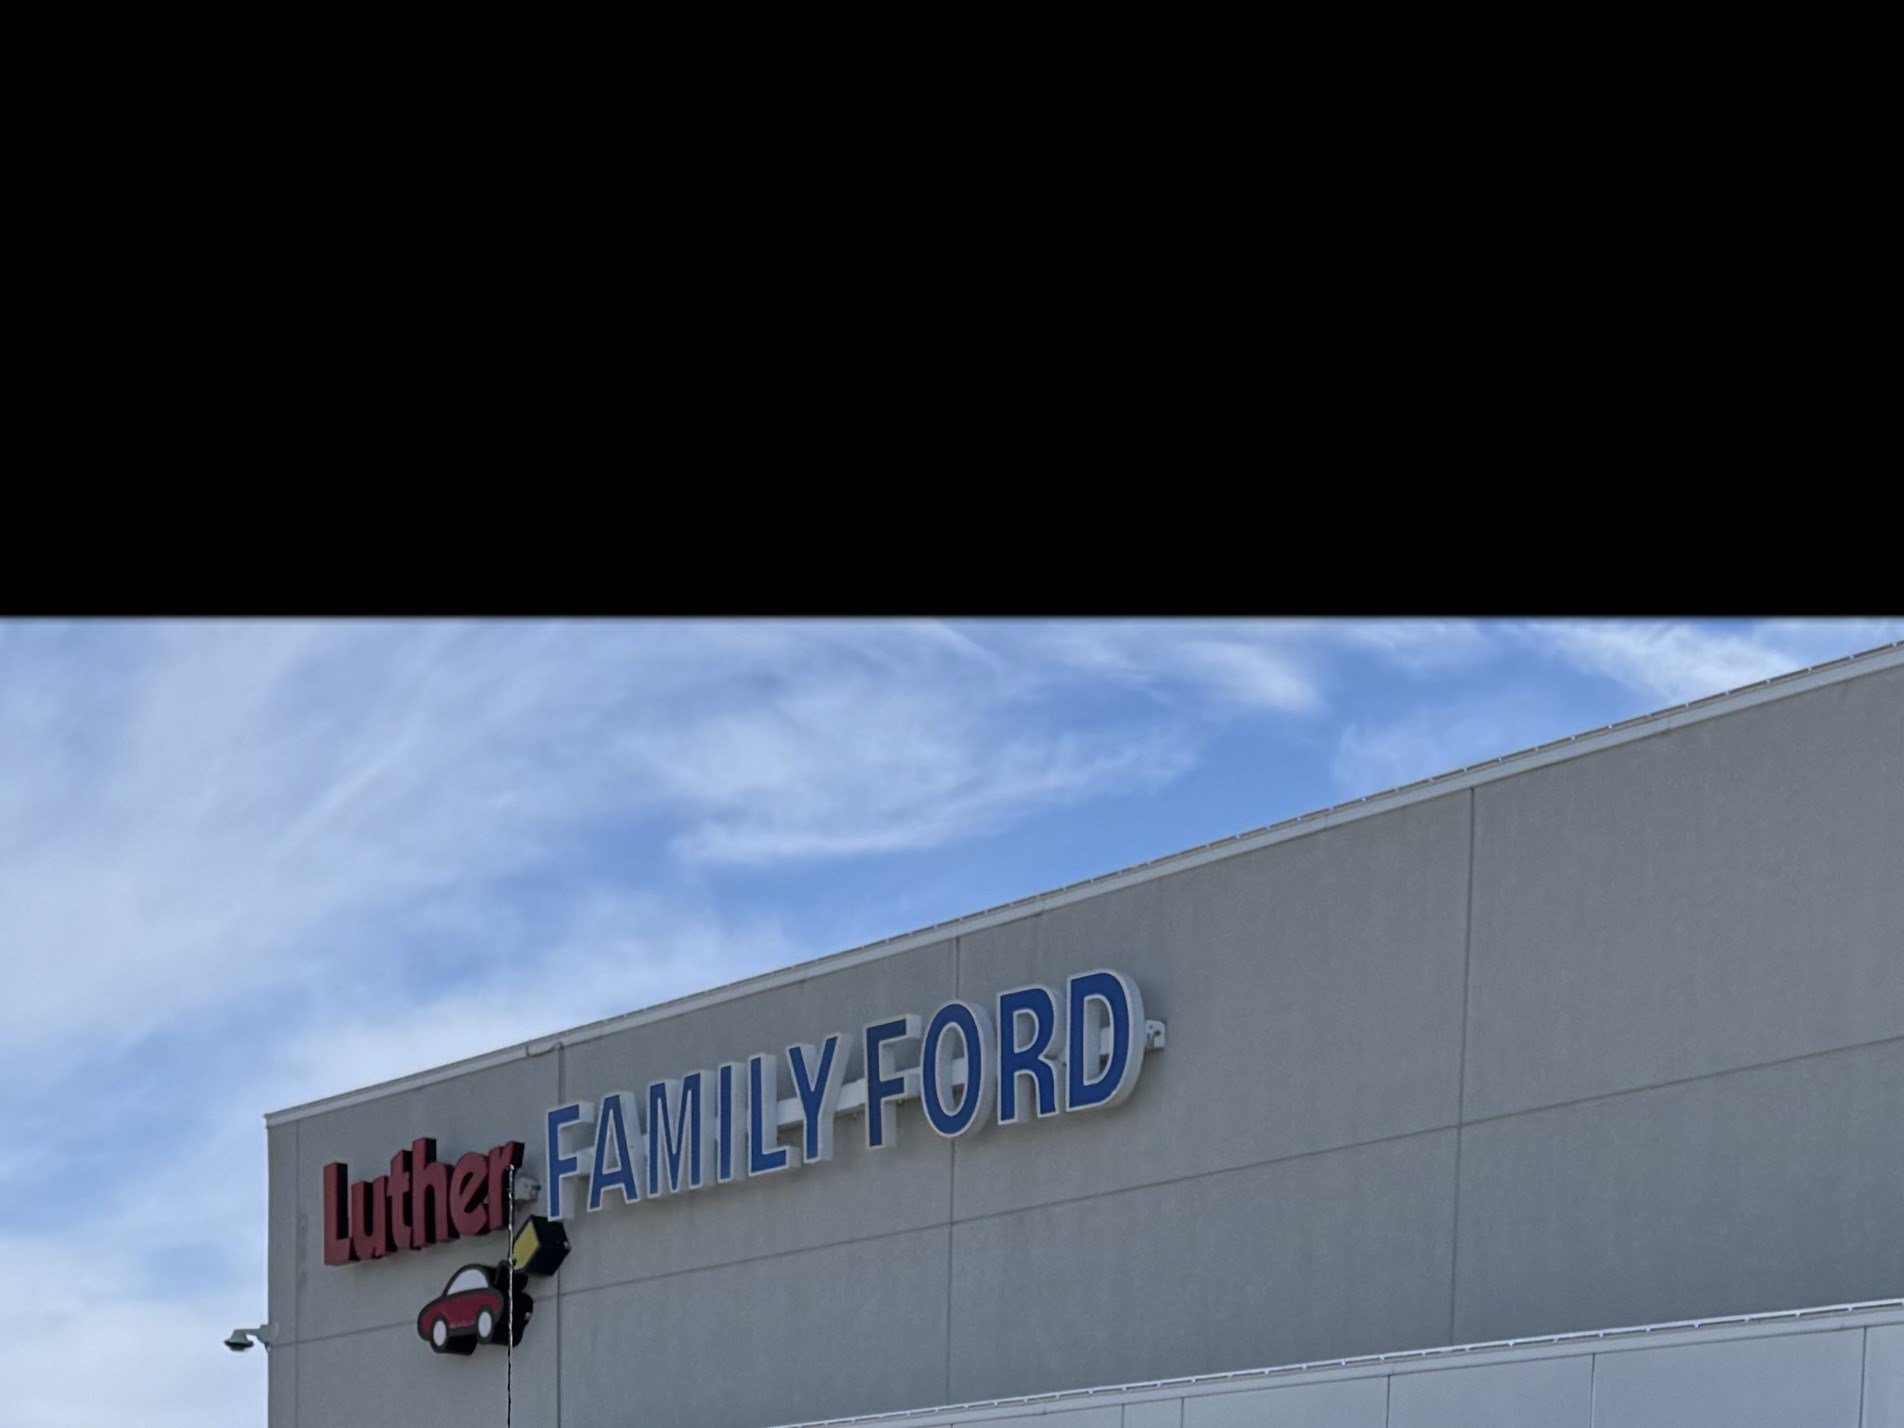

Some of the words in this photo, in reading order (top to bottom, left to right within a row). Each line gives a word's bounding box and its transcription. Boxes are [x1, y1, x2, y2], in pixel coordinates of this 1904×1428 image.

[323, 1137, 524, 1266] Luther
[546, 1032, 844, 1222] FAMILY
[865, 968, 1142, 1149] FORD
